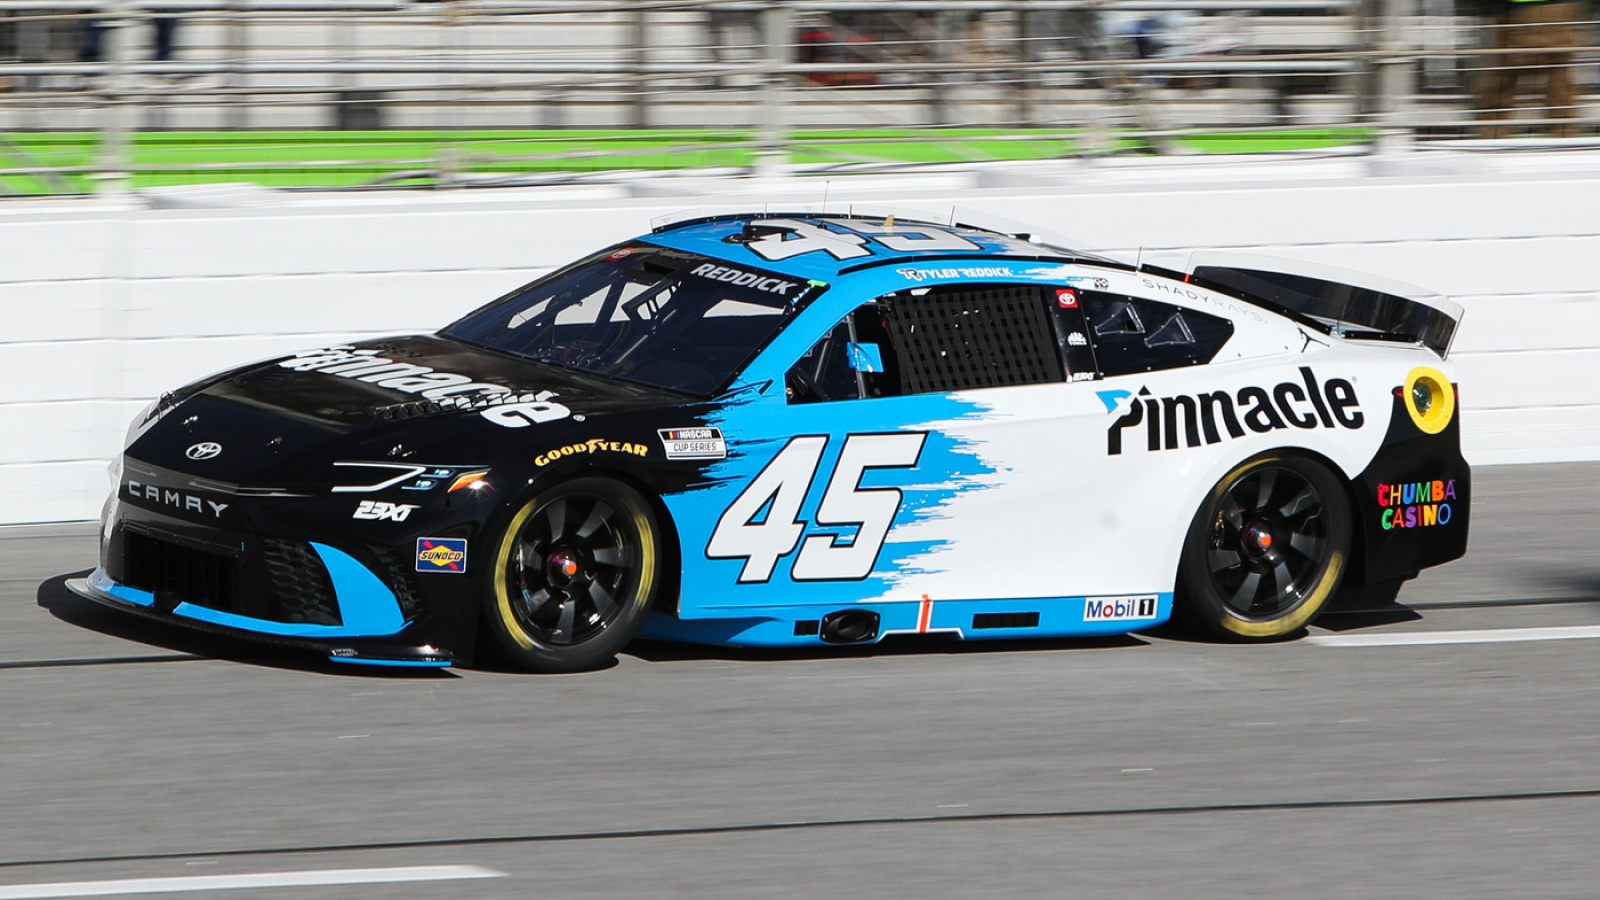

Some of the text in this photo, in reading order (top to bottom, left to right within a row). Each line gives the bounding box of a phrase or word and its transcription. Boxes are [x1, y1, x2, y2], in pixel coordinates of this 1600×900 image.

[745, 217, 984, 261] 45
[690, 262, 798, 296] REDDICK
[920, 268, 960, 279] TYLER
[959, 267, 1013, 278] REDDICK
[1095, 366, 1364, 455] Pinnacle
[673, 442, 717, 452] CUP SERIES
[679, 429, 712, 439] NASCAR
[534, 438, 648, 467] GOODYEAR
[128, 480, 229, 518] CAMRY
[1377, 480, 1456, 507] CHUMBA
[705, 431, 928, 584] 45
[1381, 503, 1451, 530] CASINO
[420, 551, 462, 561] SUNOCO
[1086, 599, 1136, 618] Mobil
